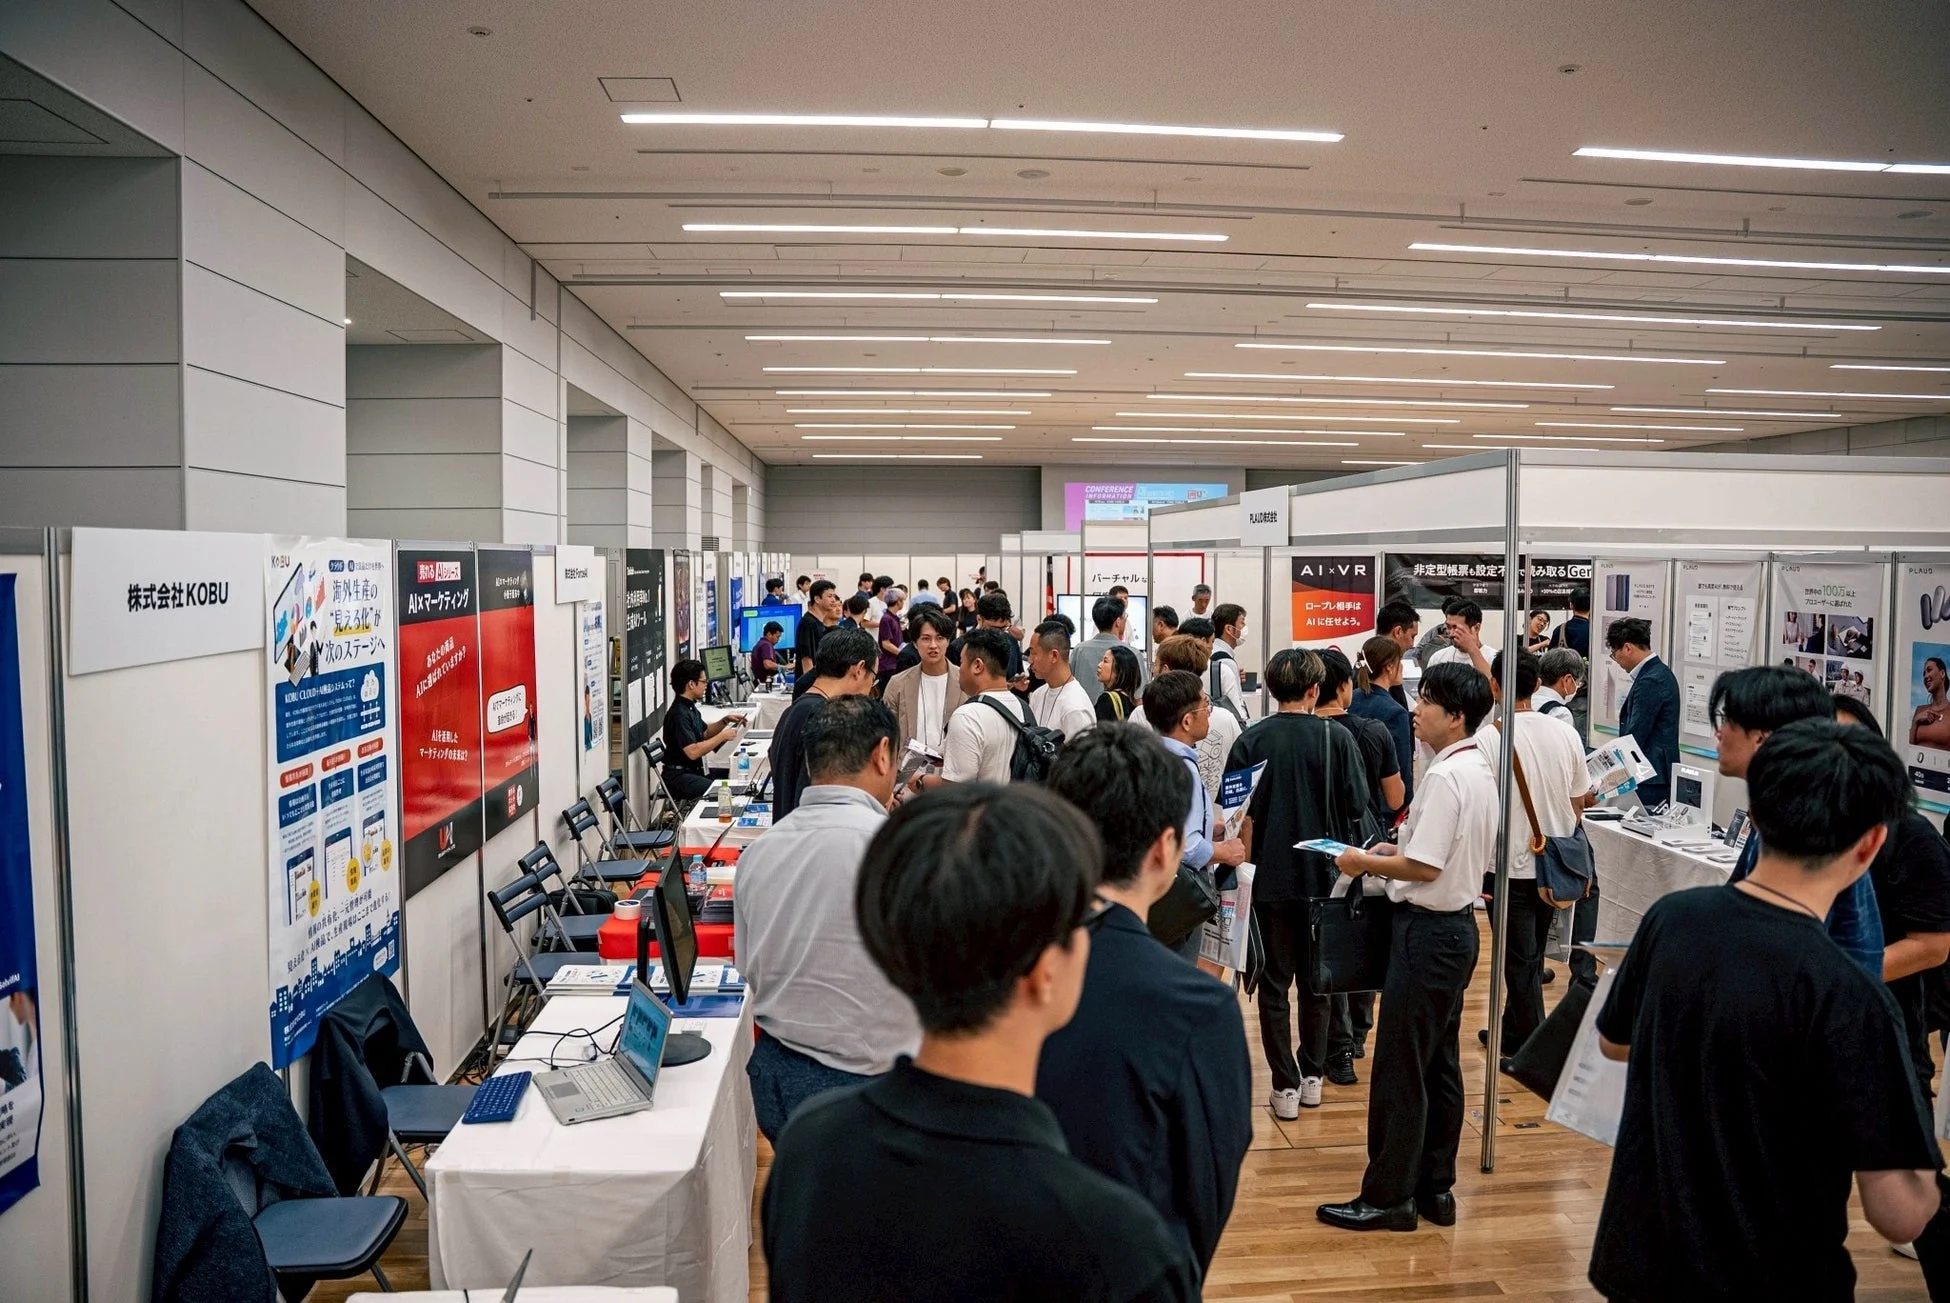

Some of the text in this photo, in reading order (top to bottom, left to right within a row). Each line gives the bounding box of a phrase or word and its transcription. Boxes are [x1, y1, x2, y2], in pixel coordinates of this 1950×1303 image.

[1085, 485, 1134, 493] CONFERENCE
[271, 555, 291, 568] KOBU
[419, 564, 435, 580] 売れる
[127, 581, 229, 612] 株式会社KOBU
[332, 578, 378, 604] 海外生産の
[408, 588, 470, 615] AI×マーケティング
[1305, 601, 1361, 611] ロープレ相手は
[325, 635, 386, 665] 次のステージへ
